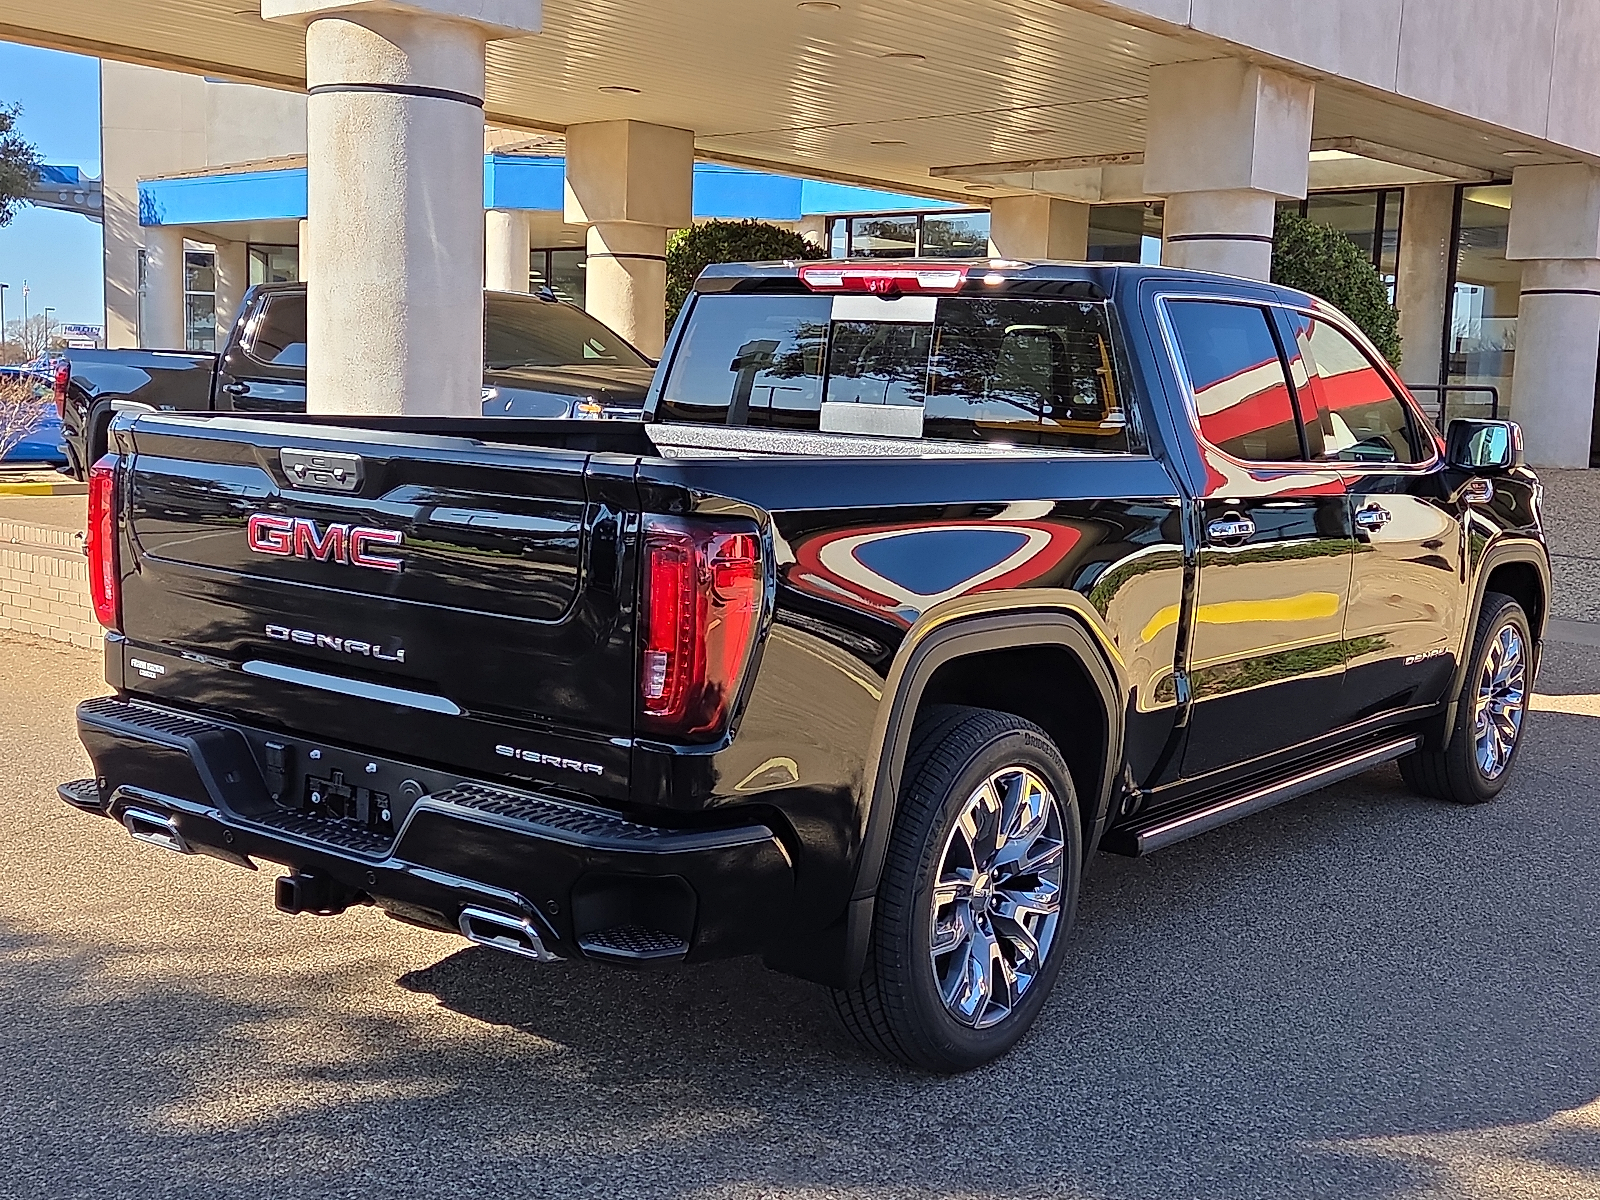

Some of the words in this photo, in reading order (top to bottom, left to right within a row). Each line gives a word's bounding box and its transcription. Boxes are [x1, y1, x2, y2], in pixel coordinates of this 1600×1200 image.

[248, 512, 405, 574] GMC
[265, 624, 405, 663] DENALI
[1403, 646, 1449, 666] DENALI
[495, 744, 604, 776] SIERRA
